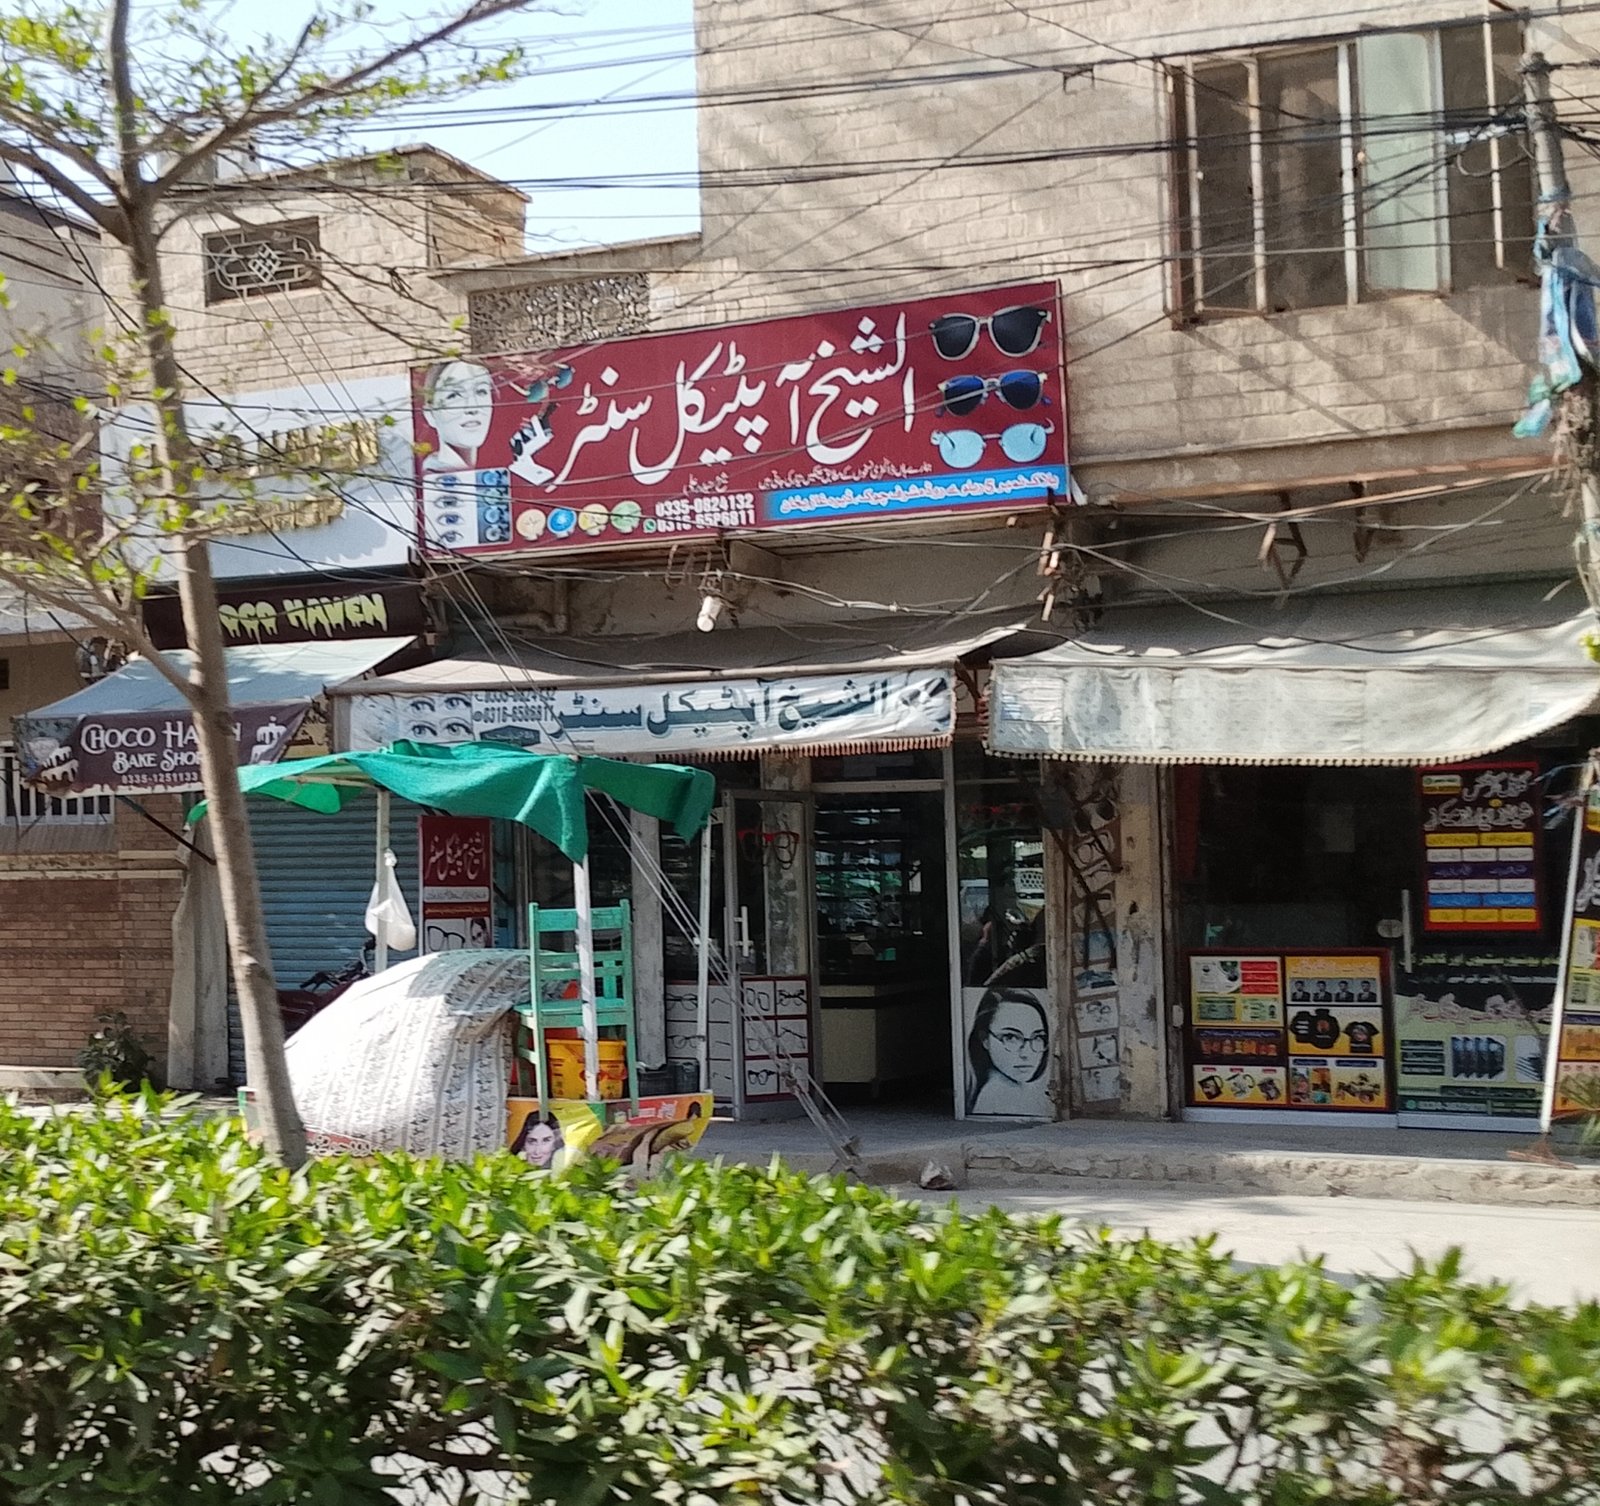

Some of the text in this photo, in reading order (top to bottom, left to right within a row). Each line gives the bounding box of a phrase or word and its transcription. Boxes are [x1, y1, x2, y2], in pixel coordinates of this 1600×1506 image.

[806, 311, 916, 465] الشیخ
[545, 366, 652, 493] سنٹر
[655, 493, 754, 517] 0335-0824132
[218, 593, 388, 645] OCO HAVEN
[81, 723, 156, 755] CHOCO
[112, 750, 158, 775] BAKE
